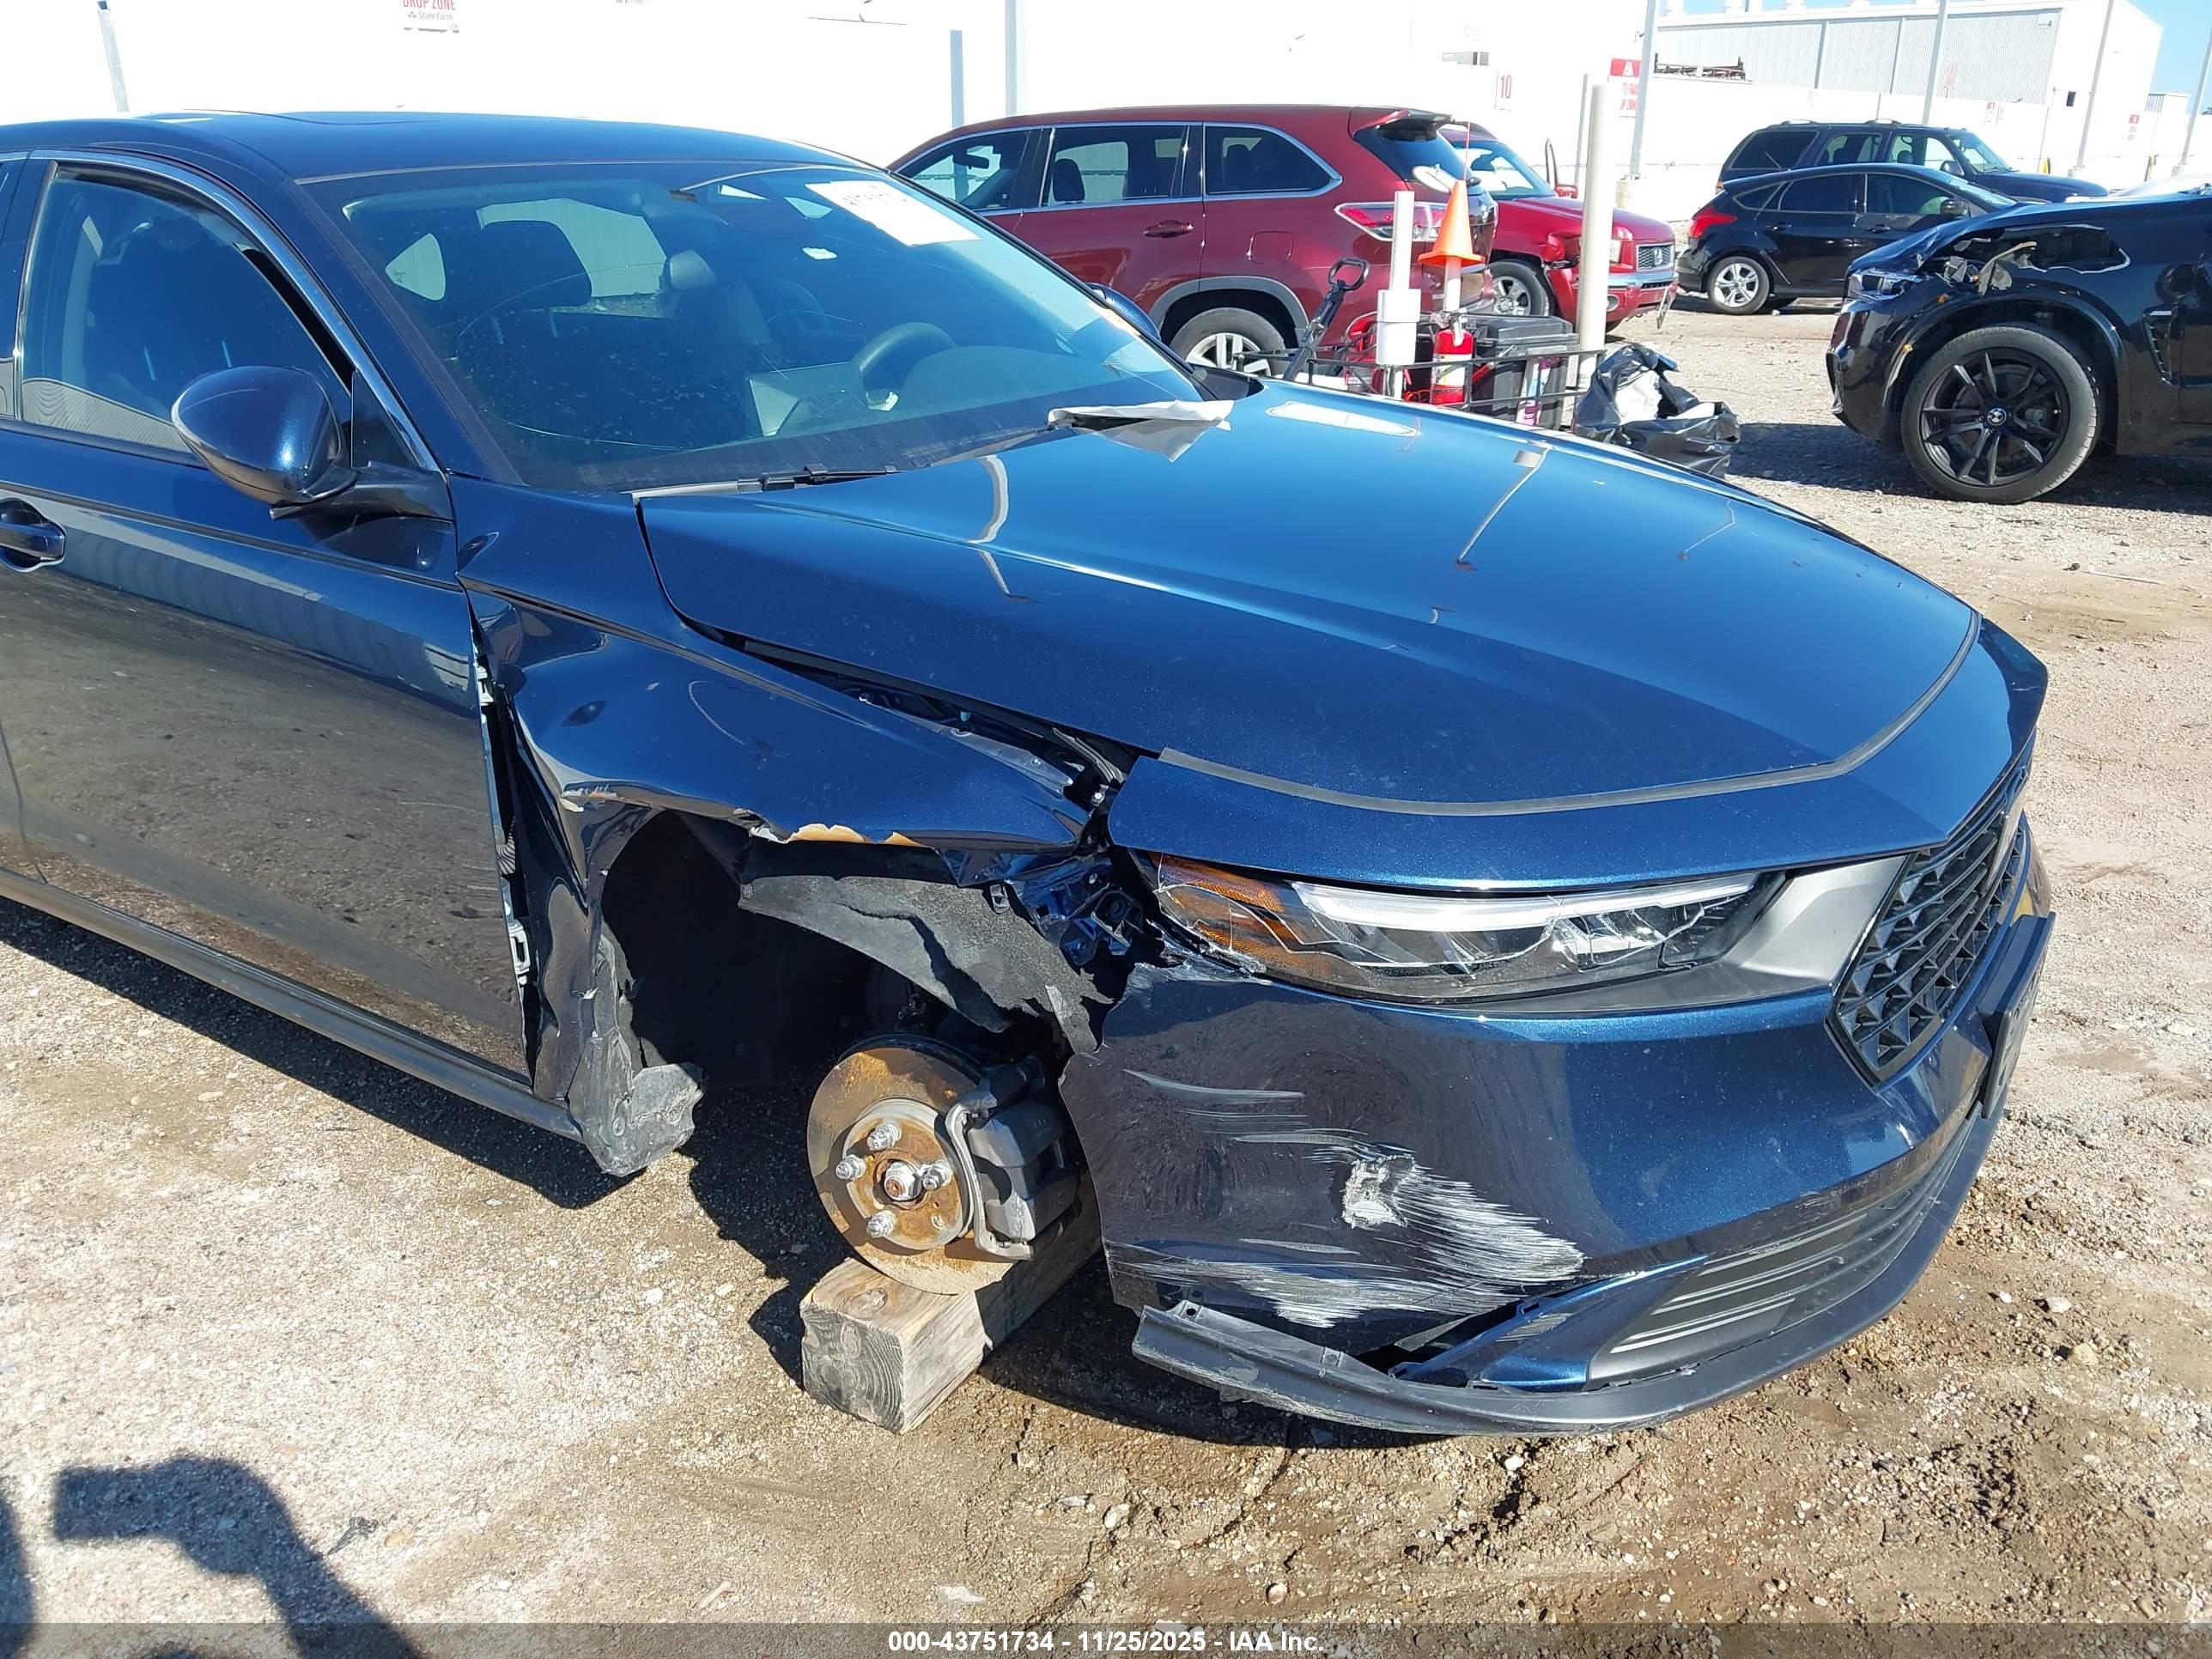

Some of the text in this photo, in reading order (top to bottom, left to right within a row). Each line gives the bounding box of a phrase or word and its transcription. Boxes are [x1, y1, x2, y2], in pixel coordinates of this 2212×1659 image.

[403, 0, 456, 10] DROP ZONE
[1500, 75, 1512, 99] 10
